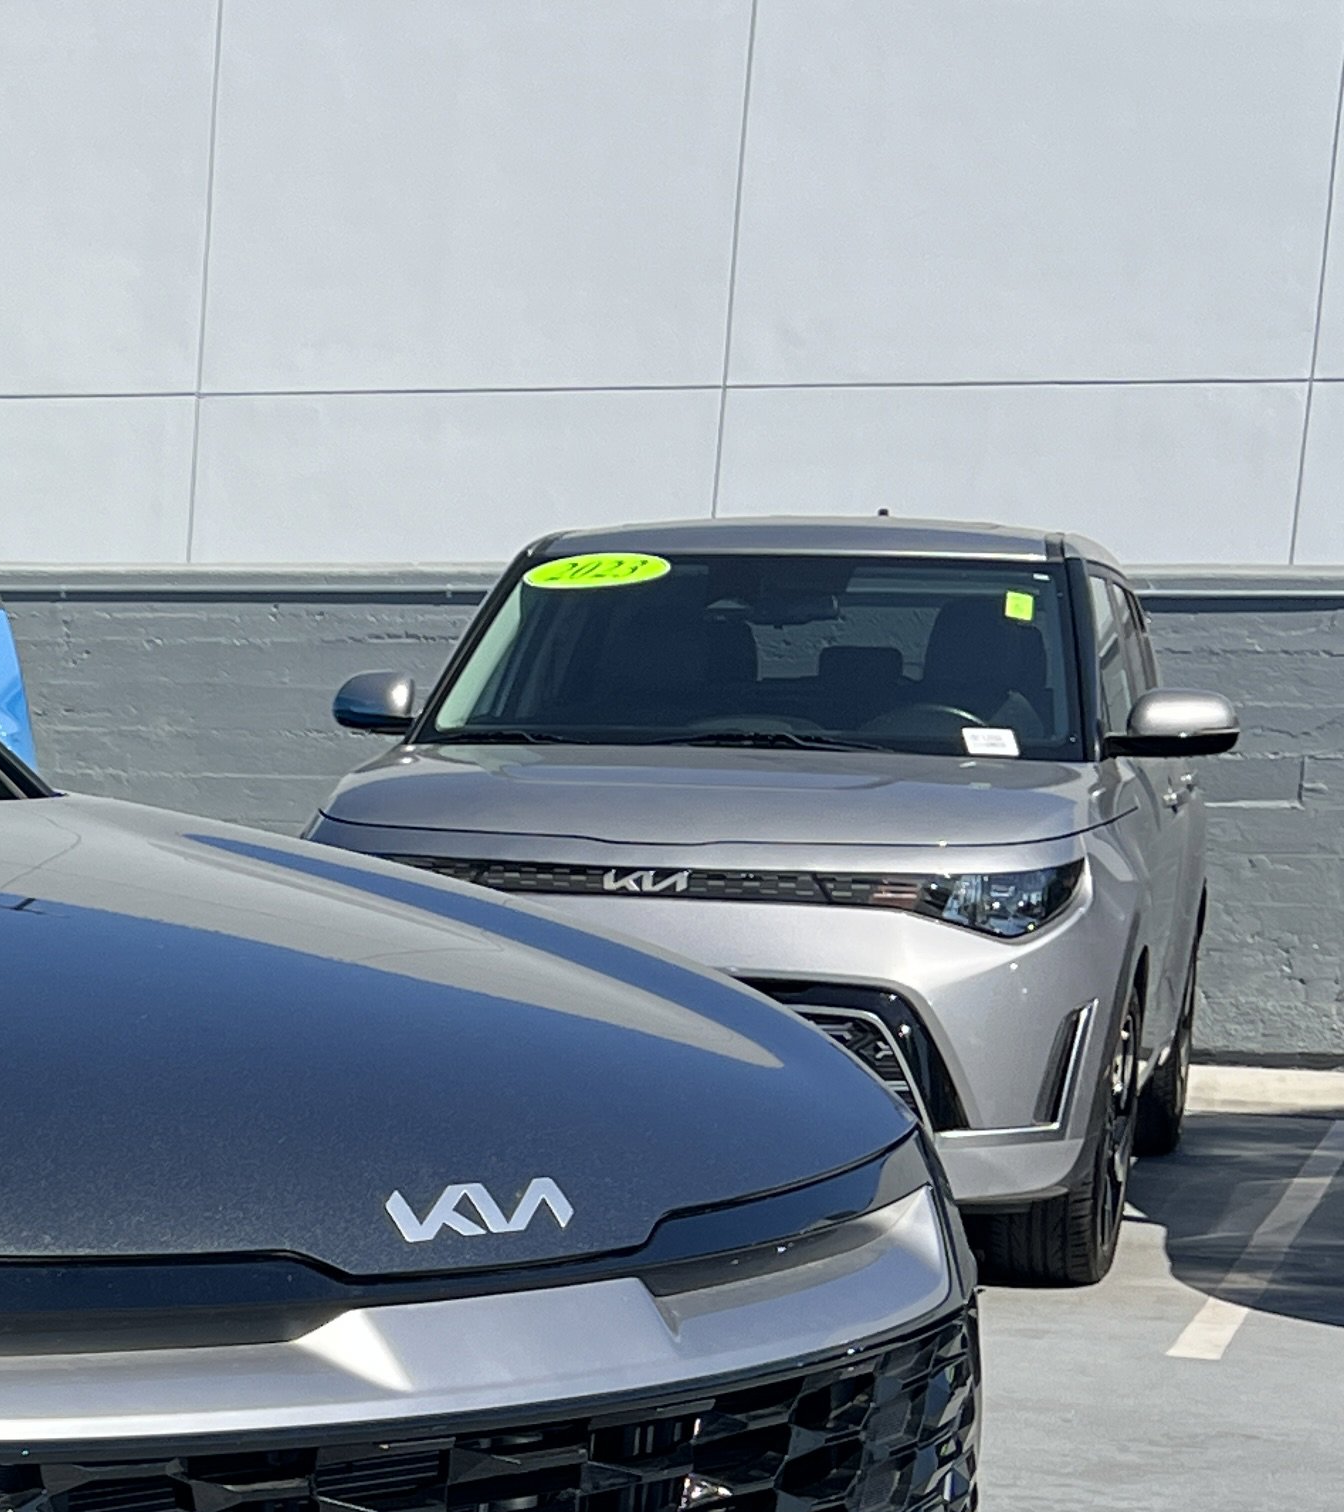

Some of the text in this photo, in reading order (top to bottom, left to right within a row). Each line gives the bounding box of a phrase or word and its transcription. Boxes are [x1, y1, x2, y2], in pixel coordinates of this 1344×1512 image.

[543, 559, 649, 582] 2023
[603, 869, 692, 893] KIA
[385, 1176, 575, 1243] KIA
